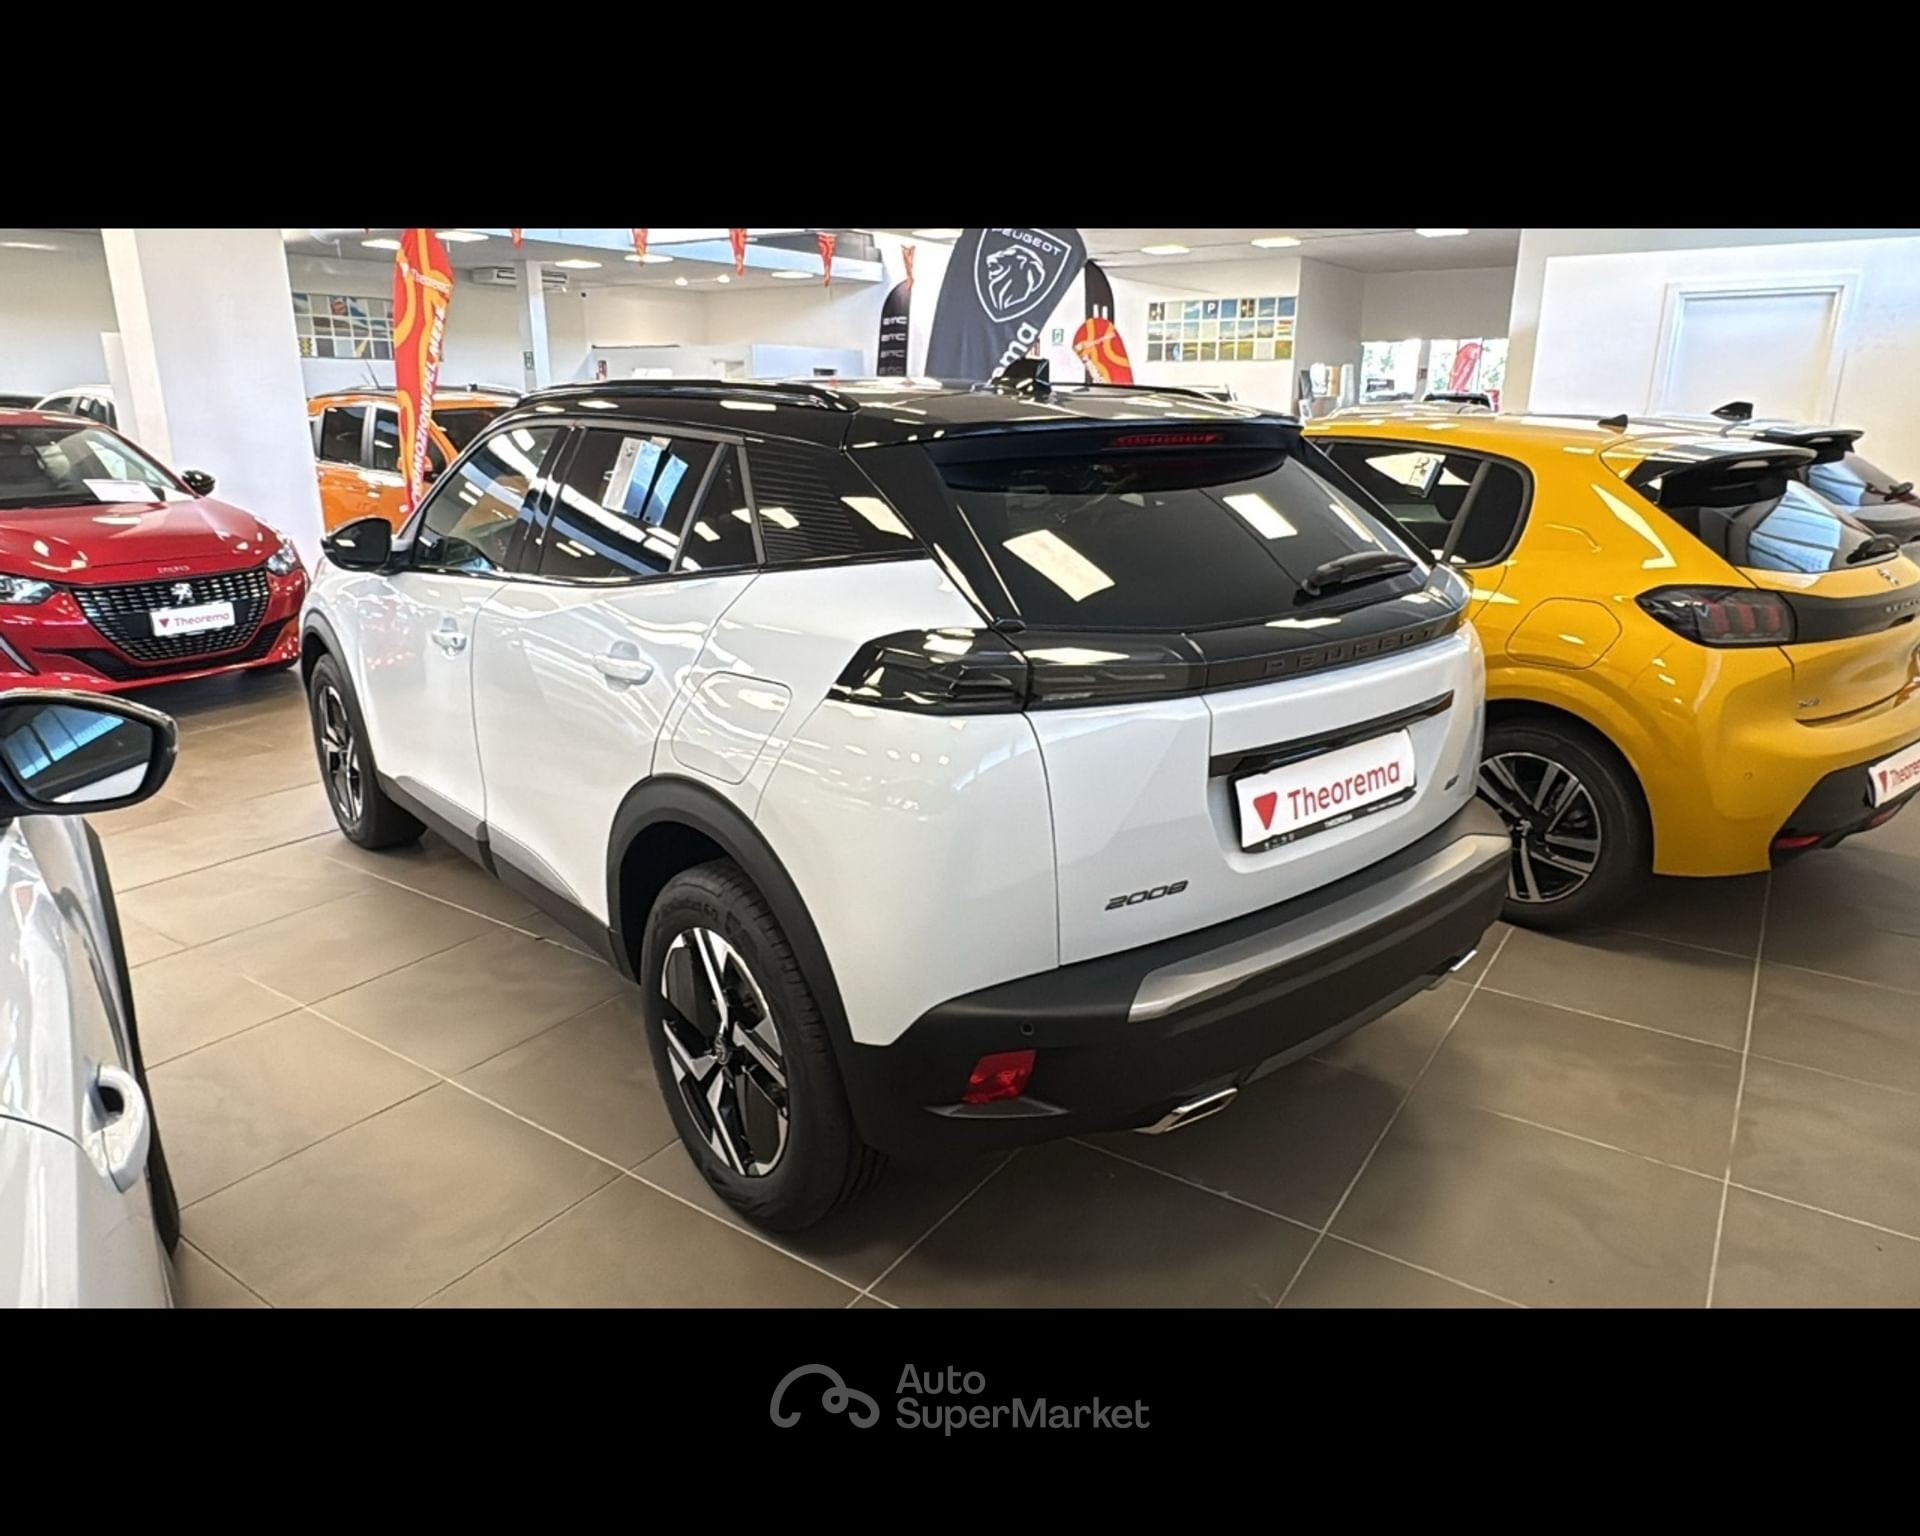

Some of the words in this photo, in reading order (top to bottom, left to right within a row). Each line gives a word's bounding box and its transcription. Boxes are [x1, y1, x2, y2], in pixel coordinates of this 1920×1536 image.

[173, 612, 230, 627] Theorema
[1287, 761, 1400, 820] Theorema
[1104, 879, 1188, 911] 2008
